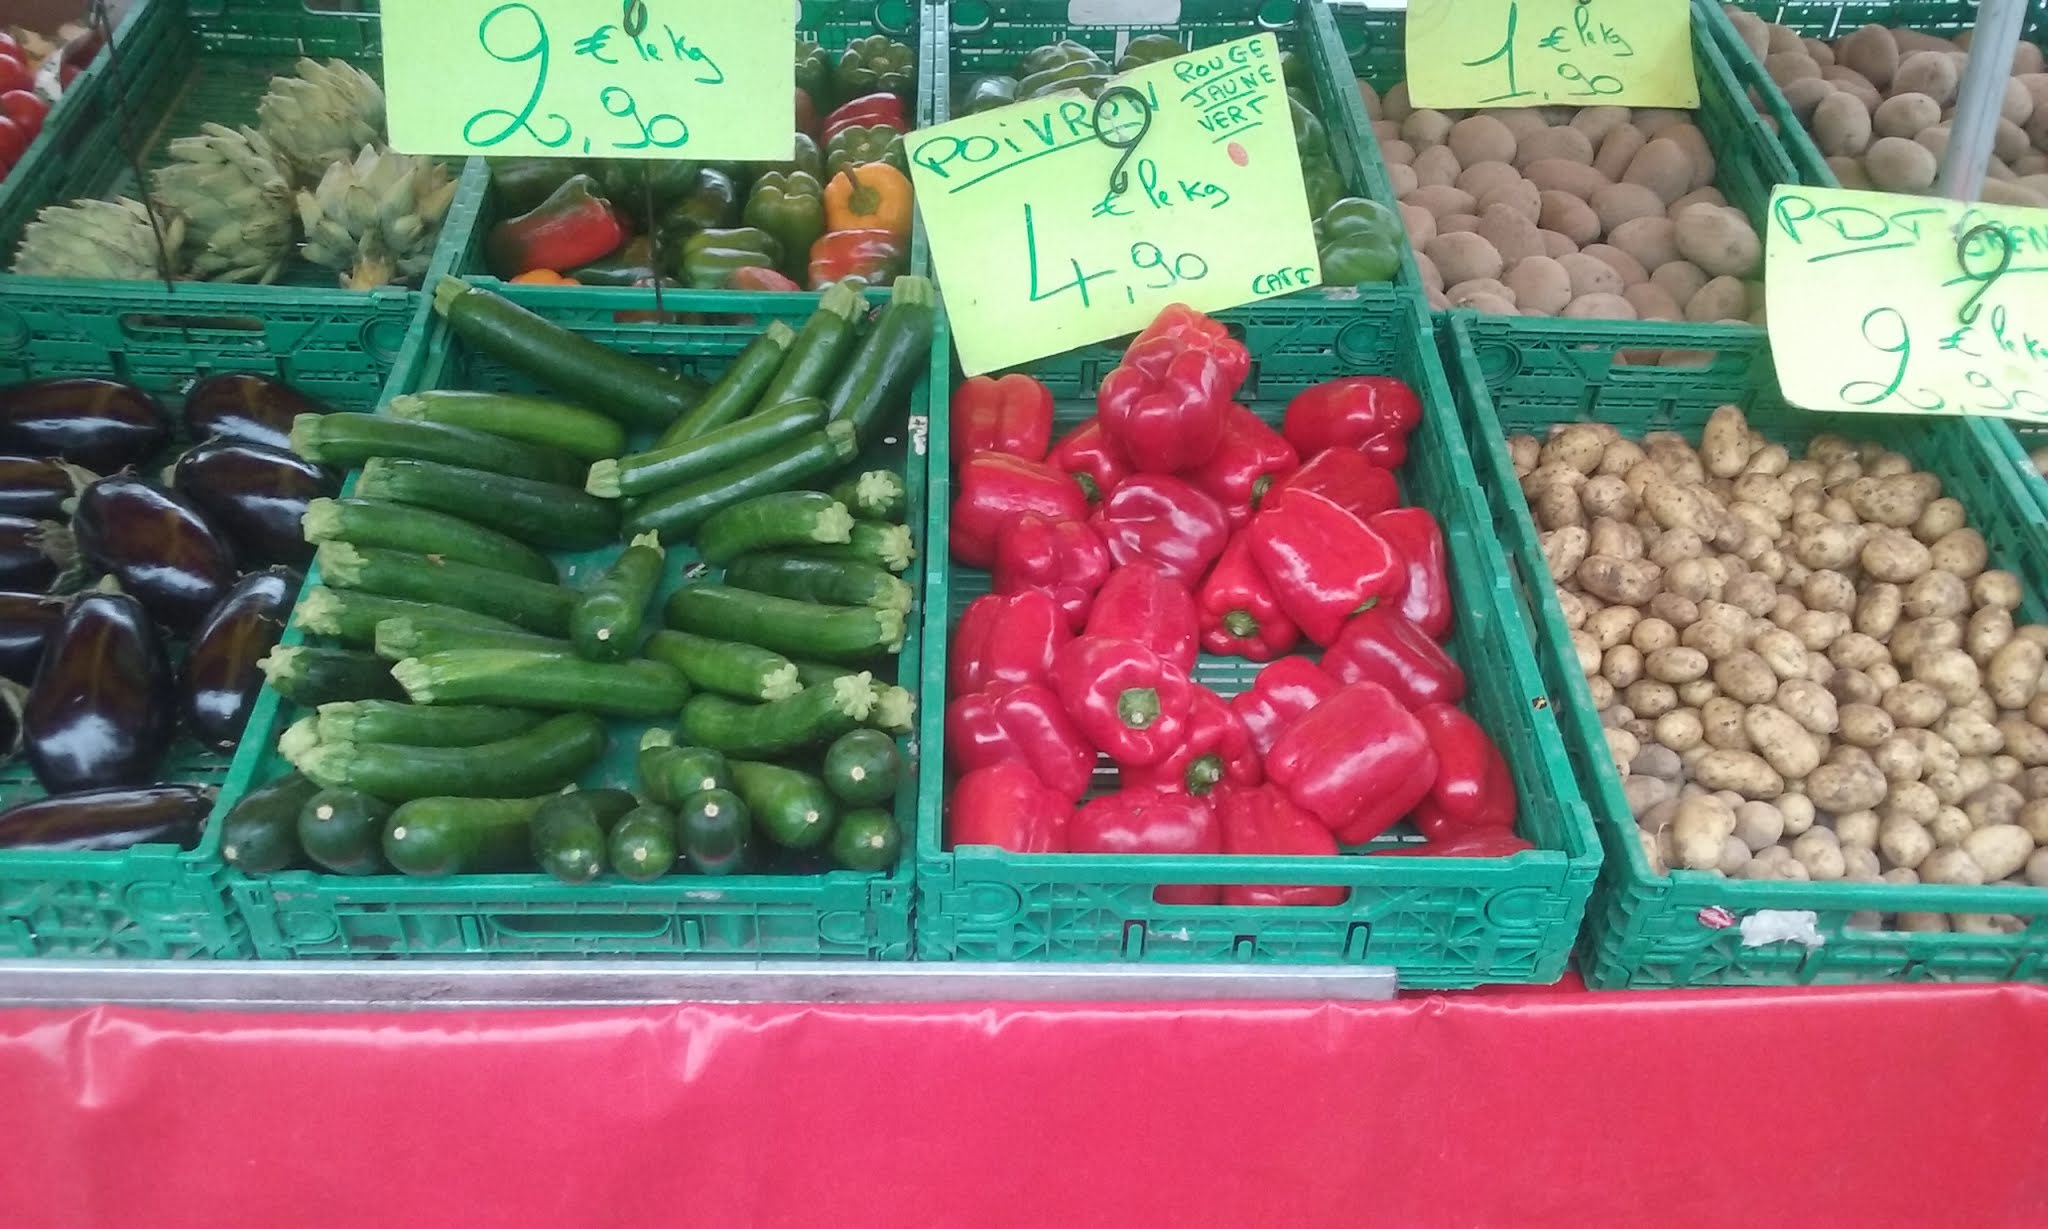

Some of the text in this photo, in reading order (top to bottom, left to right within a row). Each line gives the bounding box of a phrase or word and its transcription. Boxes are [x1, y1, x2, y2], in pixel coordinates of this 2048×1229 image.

[1173, 39, 1265, 84] ROUGE
[1180, 64, 1277, 108] JAUNE
[1197, 95, 1269, 132] VERT
[1773, 195, 1947, 245] PDT
[1024, 202, 1209, 309] 4,90
